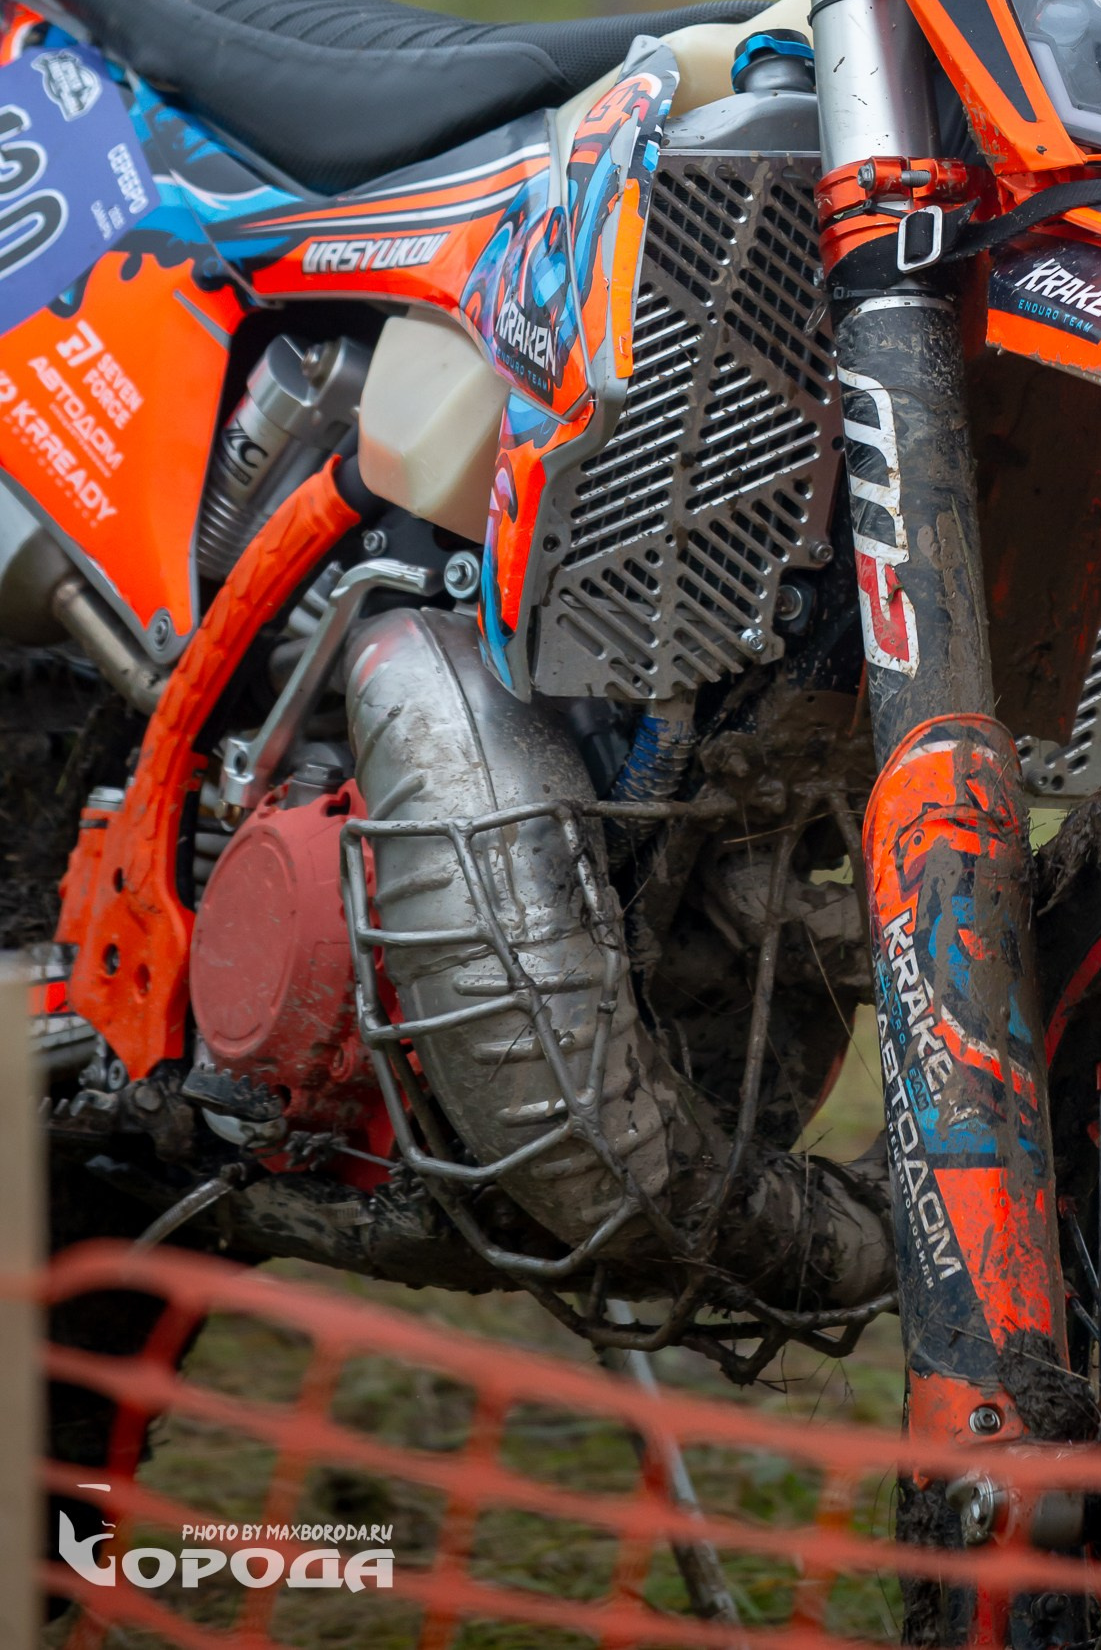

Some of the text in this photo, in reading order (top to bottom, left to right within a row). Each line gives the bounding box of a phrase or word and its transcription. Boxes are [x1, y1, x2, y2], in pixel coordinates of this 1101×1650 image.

[495, 285, 560, 377] KRAKEN
[1017, 298, 1094, 333] ENDURO TEAM
[82, 368, 133, 430] FORCE
[97, 353, 145, 413] SEVEN
[496, 348, 548, 390] ENDURO TEAM
[11, 400, 118, 522] KRREADY
[883, 910, 978, 1126] KRAKE
